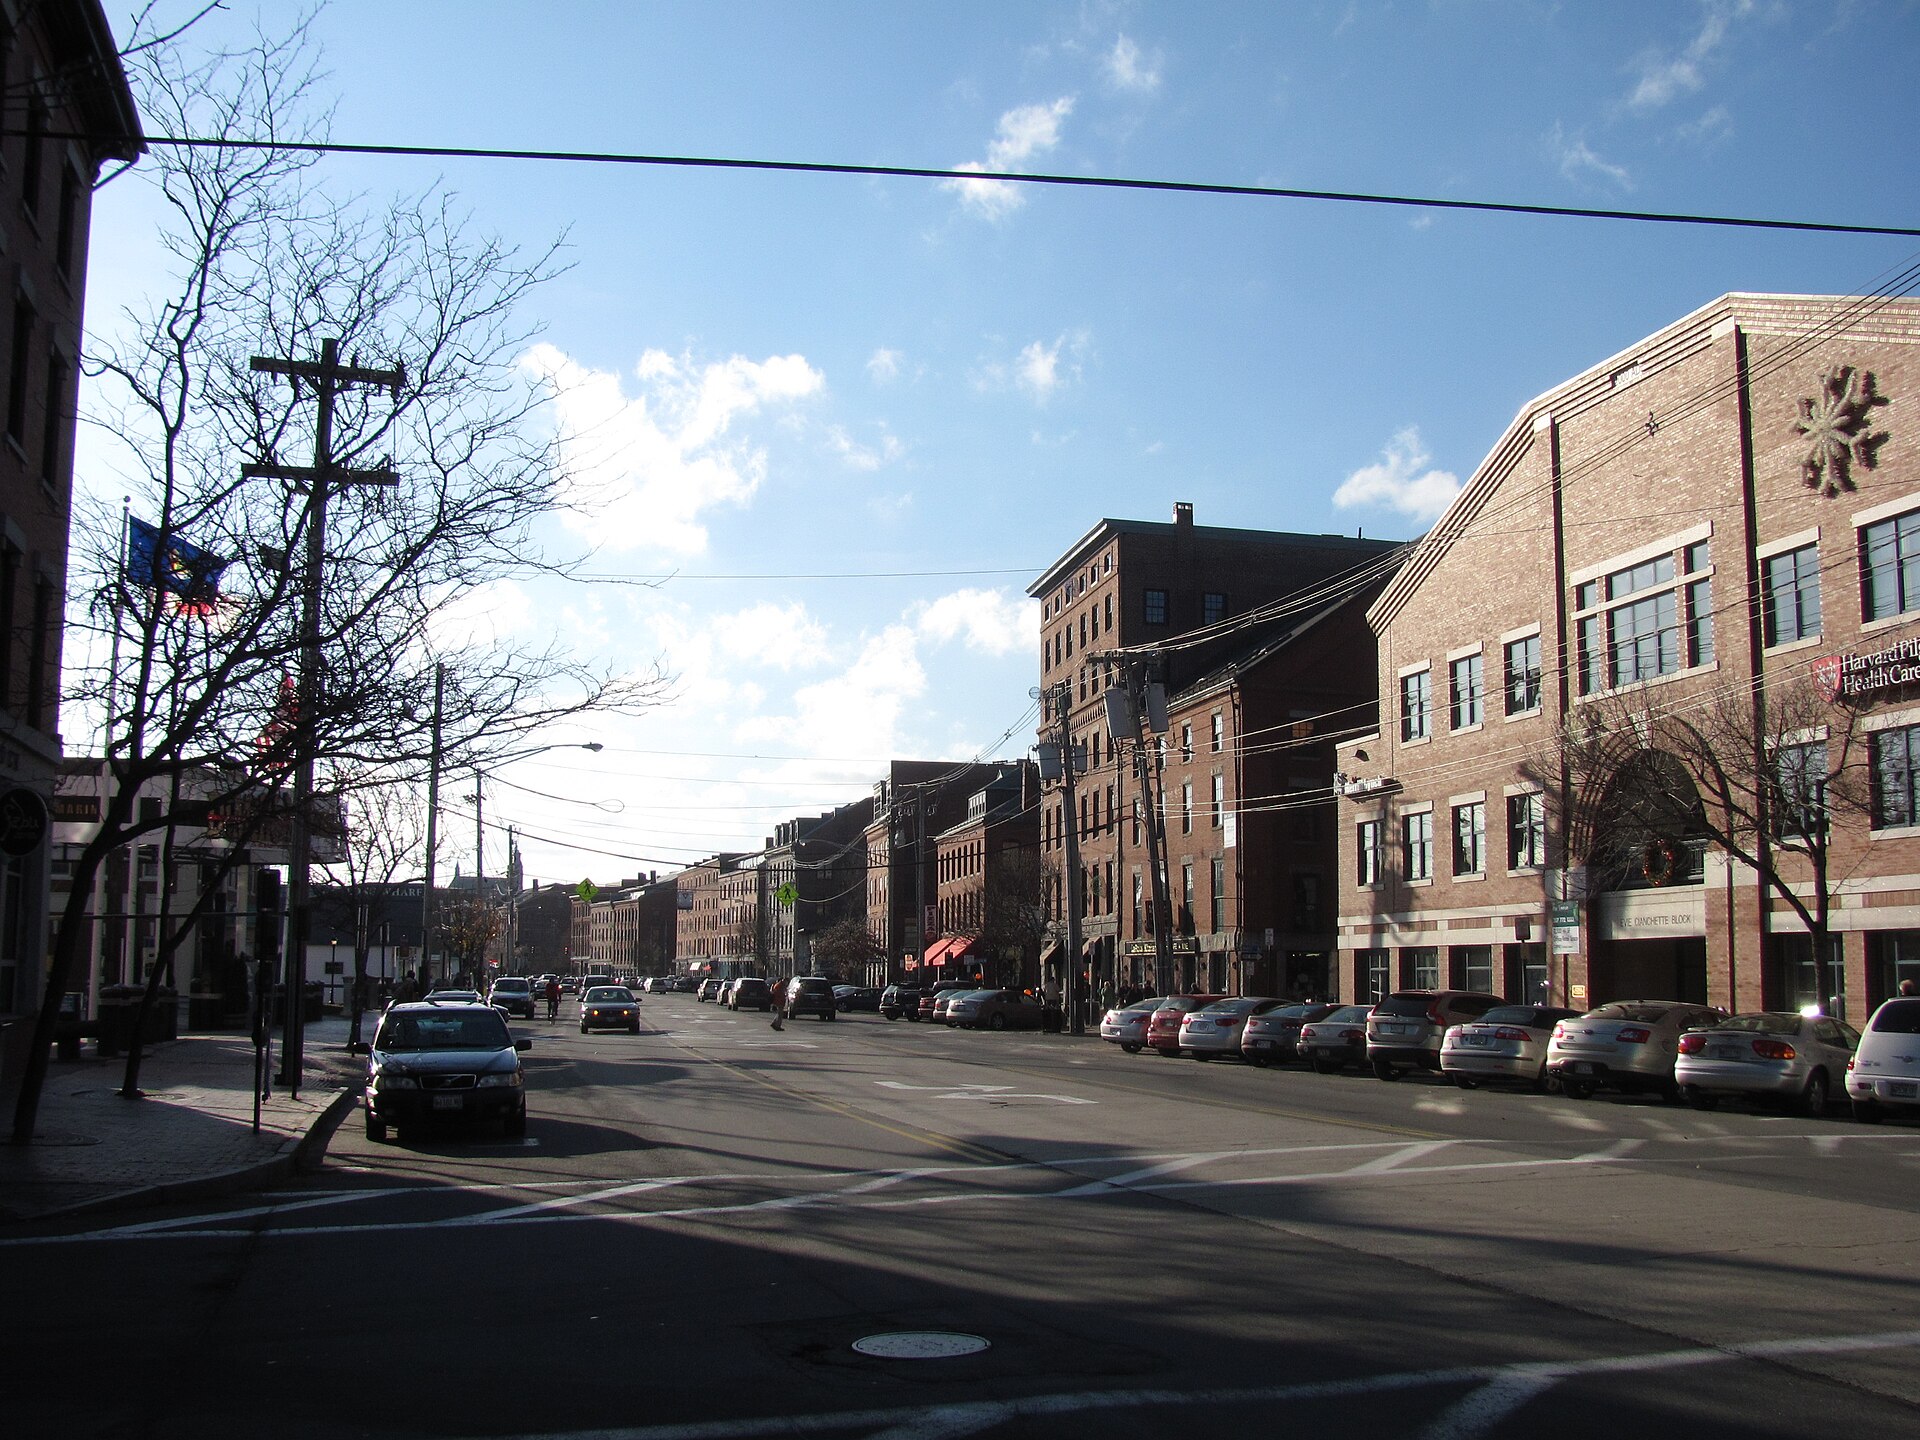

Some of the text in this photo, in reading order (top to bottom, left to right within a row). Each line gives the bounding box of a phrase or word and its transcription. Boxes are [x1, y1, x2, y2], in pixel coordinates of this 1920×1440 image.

[1842, 637, 1920, 673] Harvard Pil
[1842, 667, 1889, 695] Health
[1671, 913, 1691, 925] BLOCK
